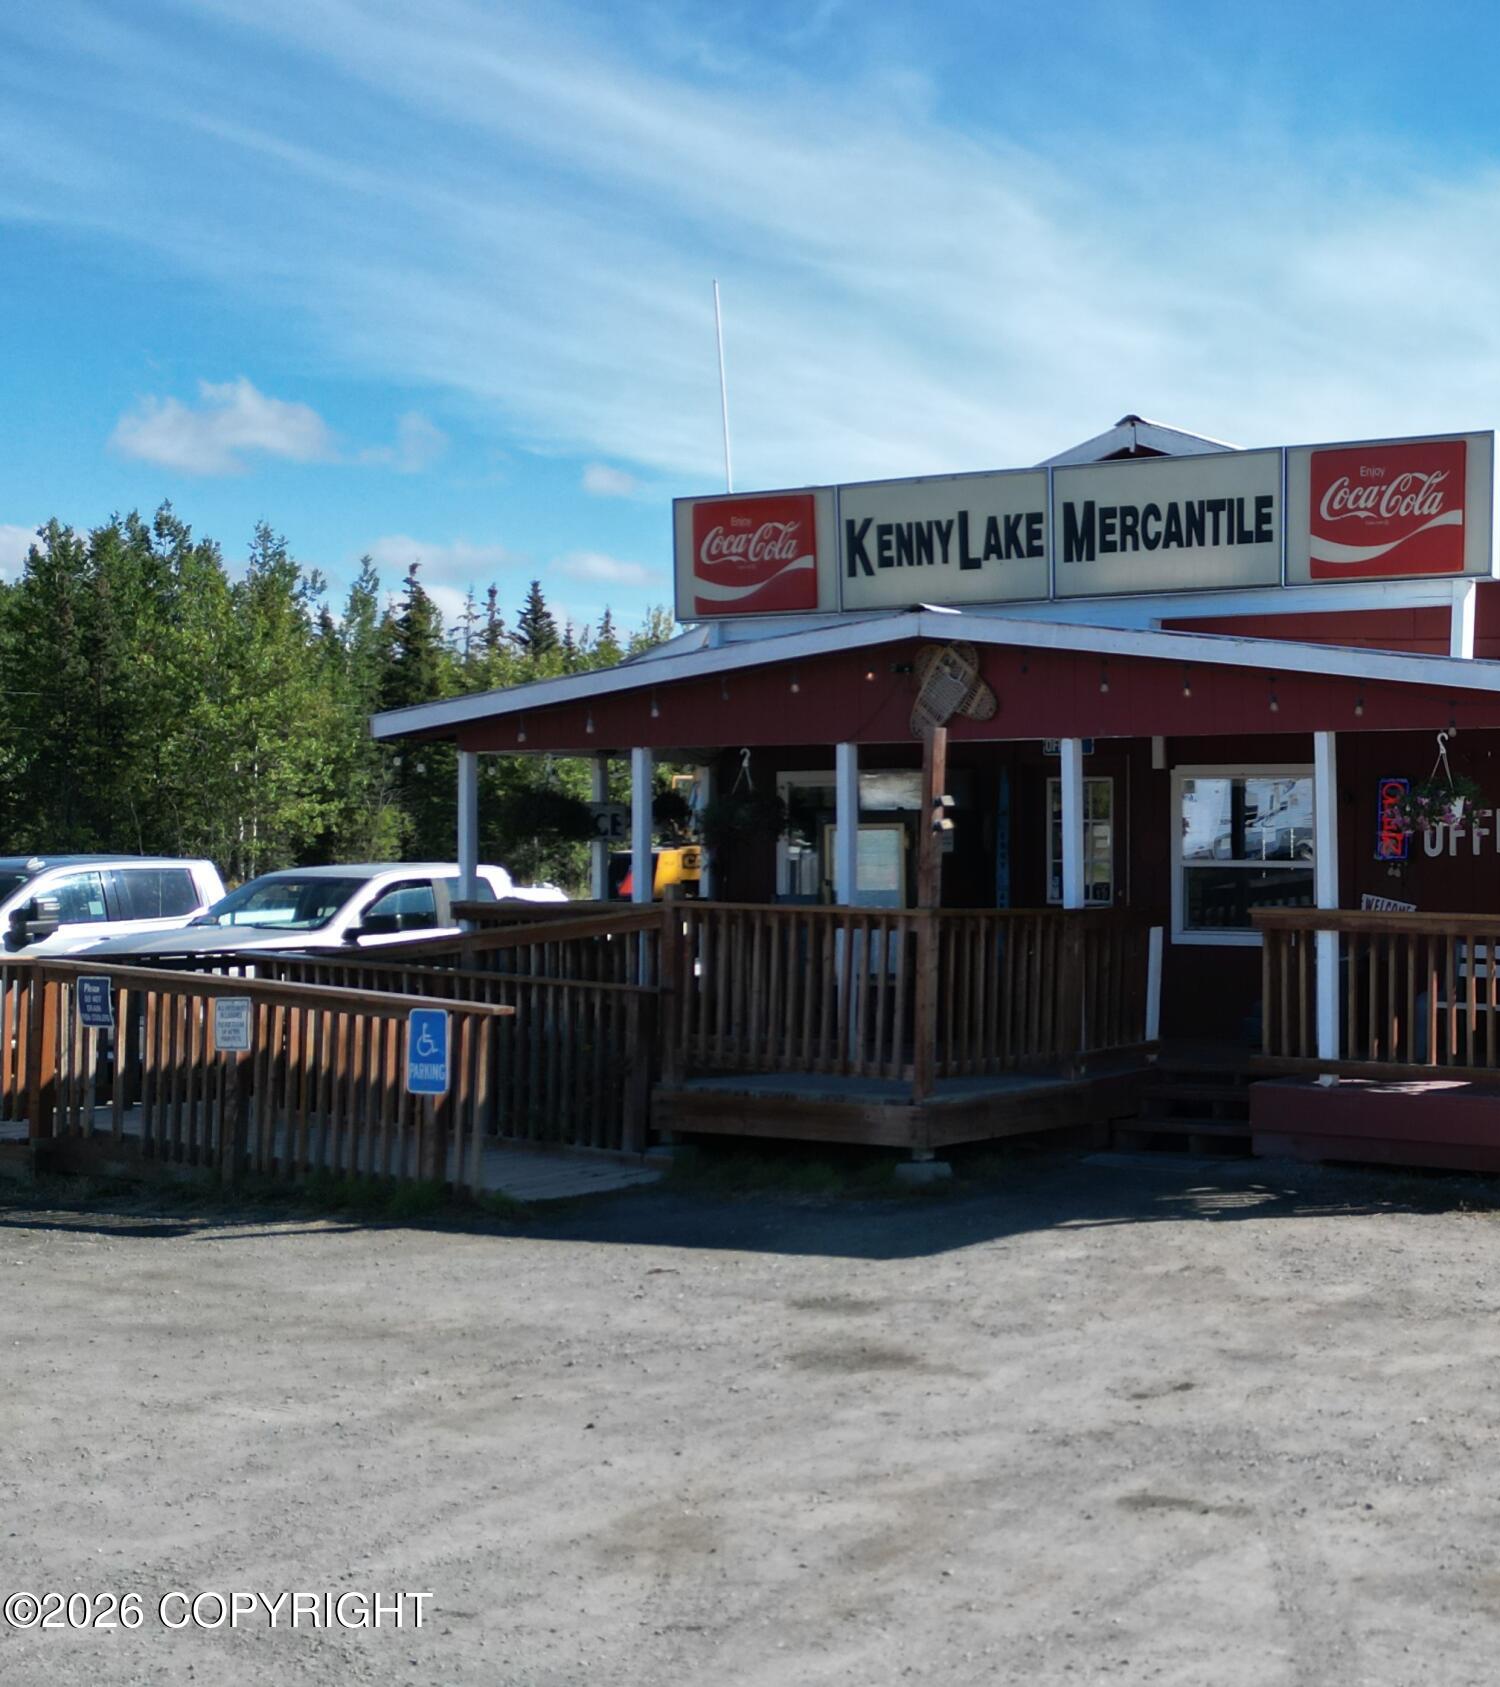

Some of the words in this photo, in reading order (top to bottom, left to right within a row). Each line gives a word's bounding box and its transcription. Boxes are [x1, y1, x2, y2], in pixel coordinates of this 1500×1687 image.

[1360, 466, 1386, 478] Enjoy
[1320, 469, 1449, 521] Coca-Cola
[701, 520, 801, 565] Coca-Cola
[846, 517, 955, 578] KENNY
[958, 510, 1045, 570] LAKE
[1063, 495, 1274, 563] MERCANTILE
[408, 1062, 446, 1081] PARKING
